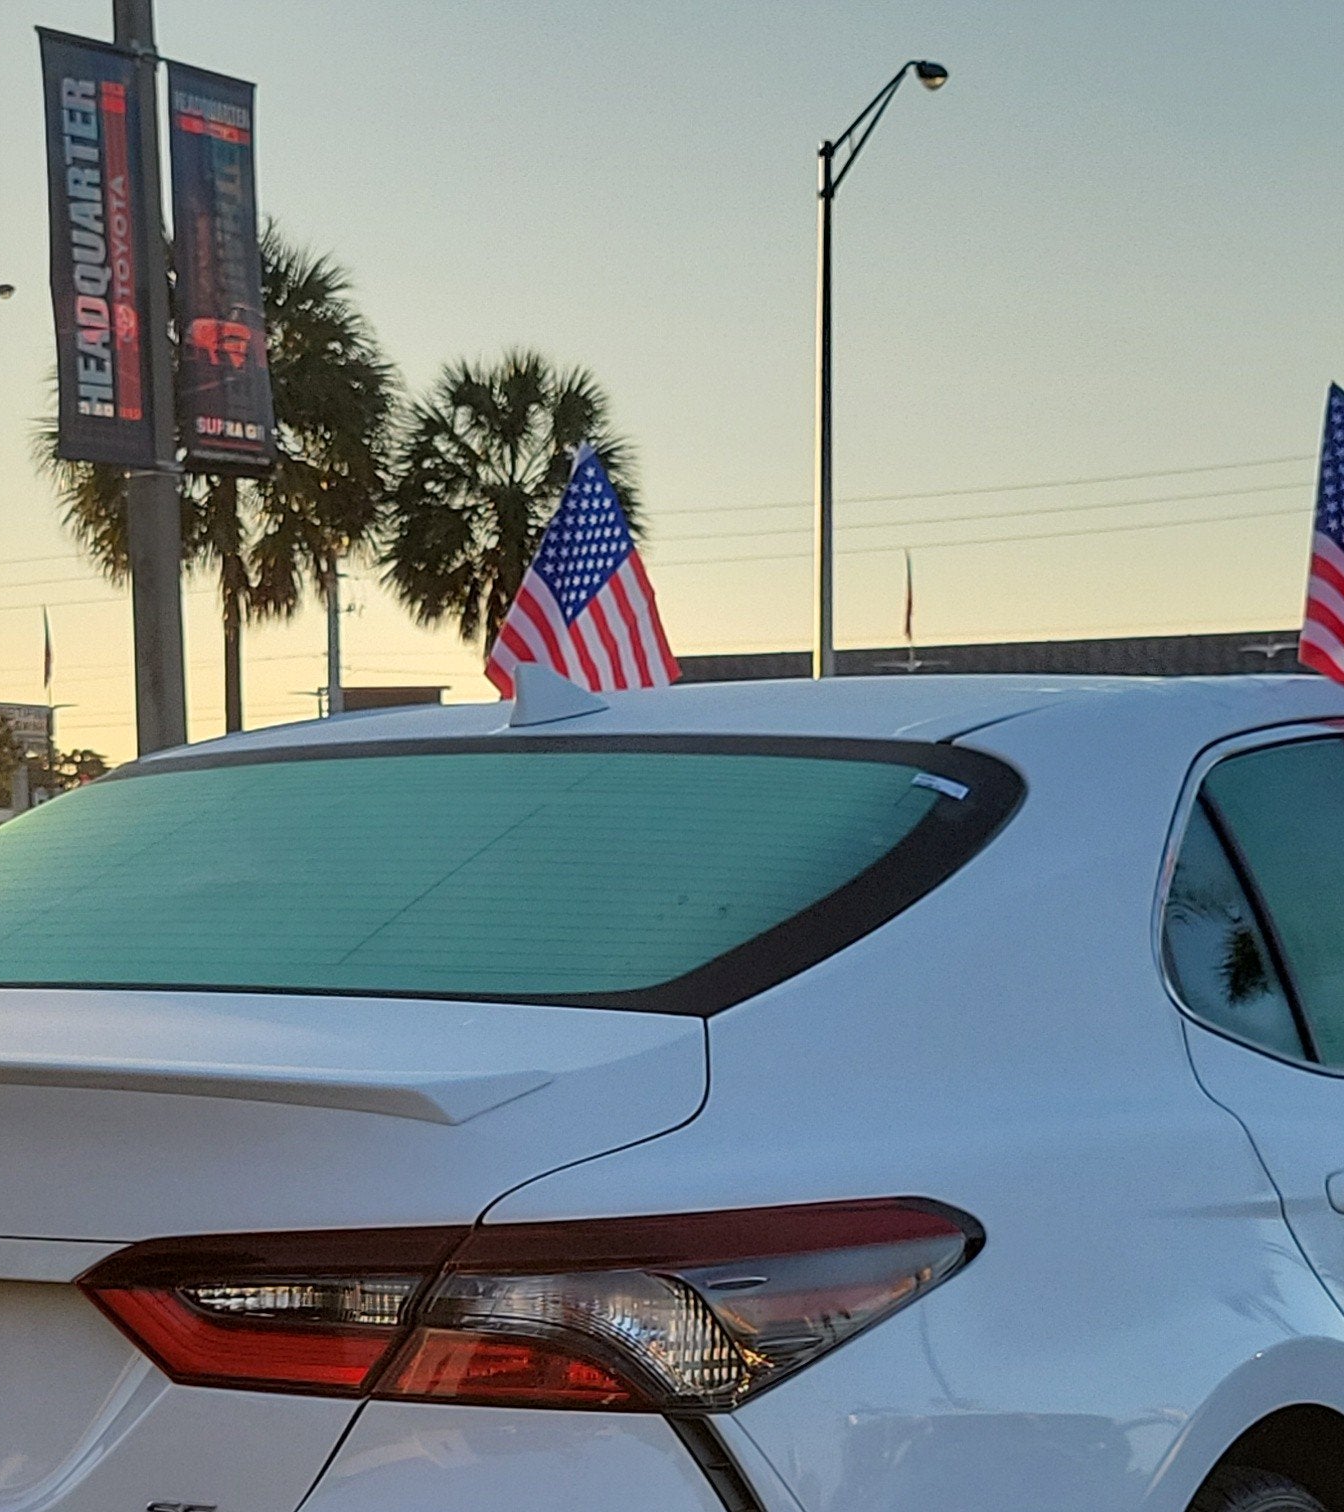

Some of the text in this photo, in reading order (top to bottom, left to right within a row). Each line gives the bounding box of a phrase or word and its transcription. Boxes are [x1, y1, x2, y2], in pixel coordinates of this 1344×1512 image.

[172, 91, 249, 130] HEADQUARTER
[61, 78, 114, 418] HEADQUARTER
[110, 176, 131, 298] TOYOTA
